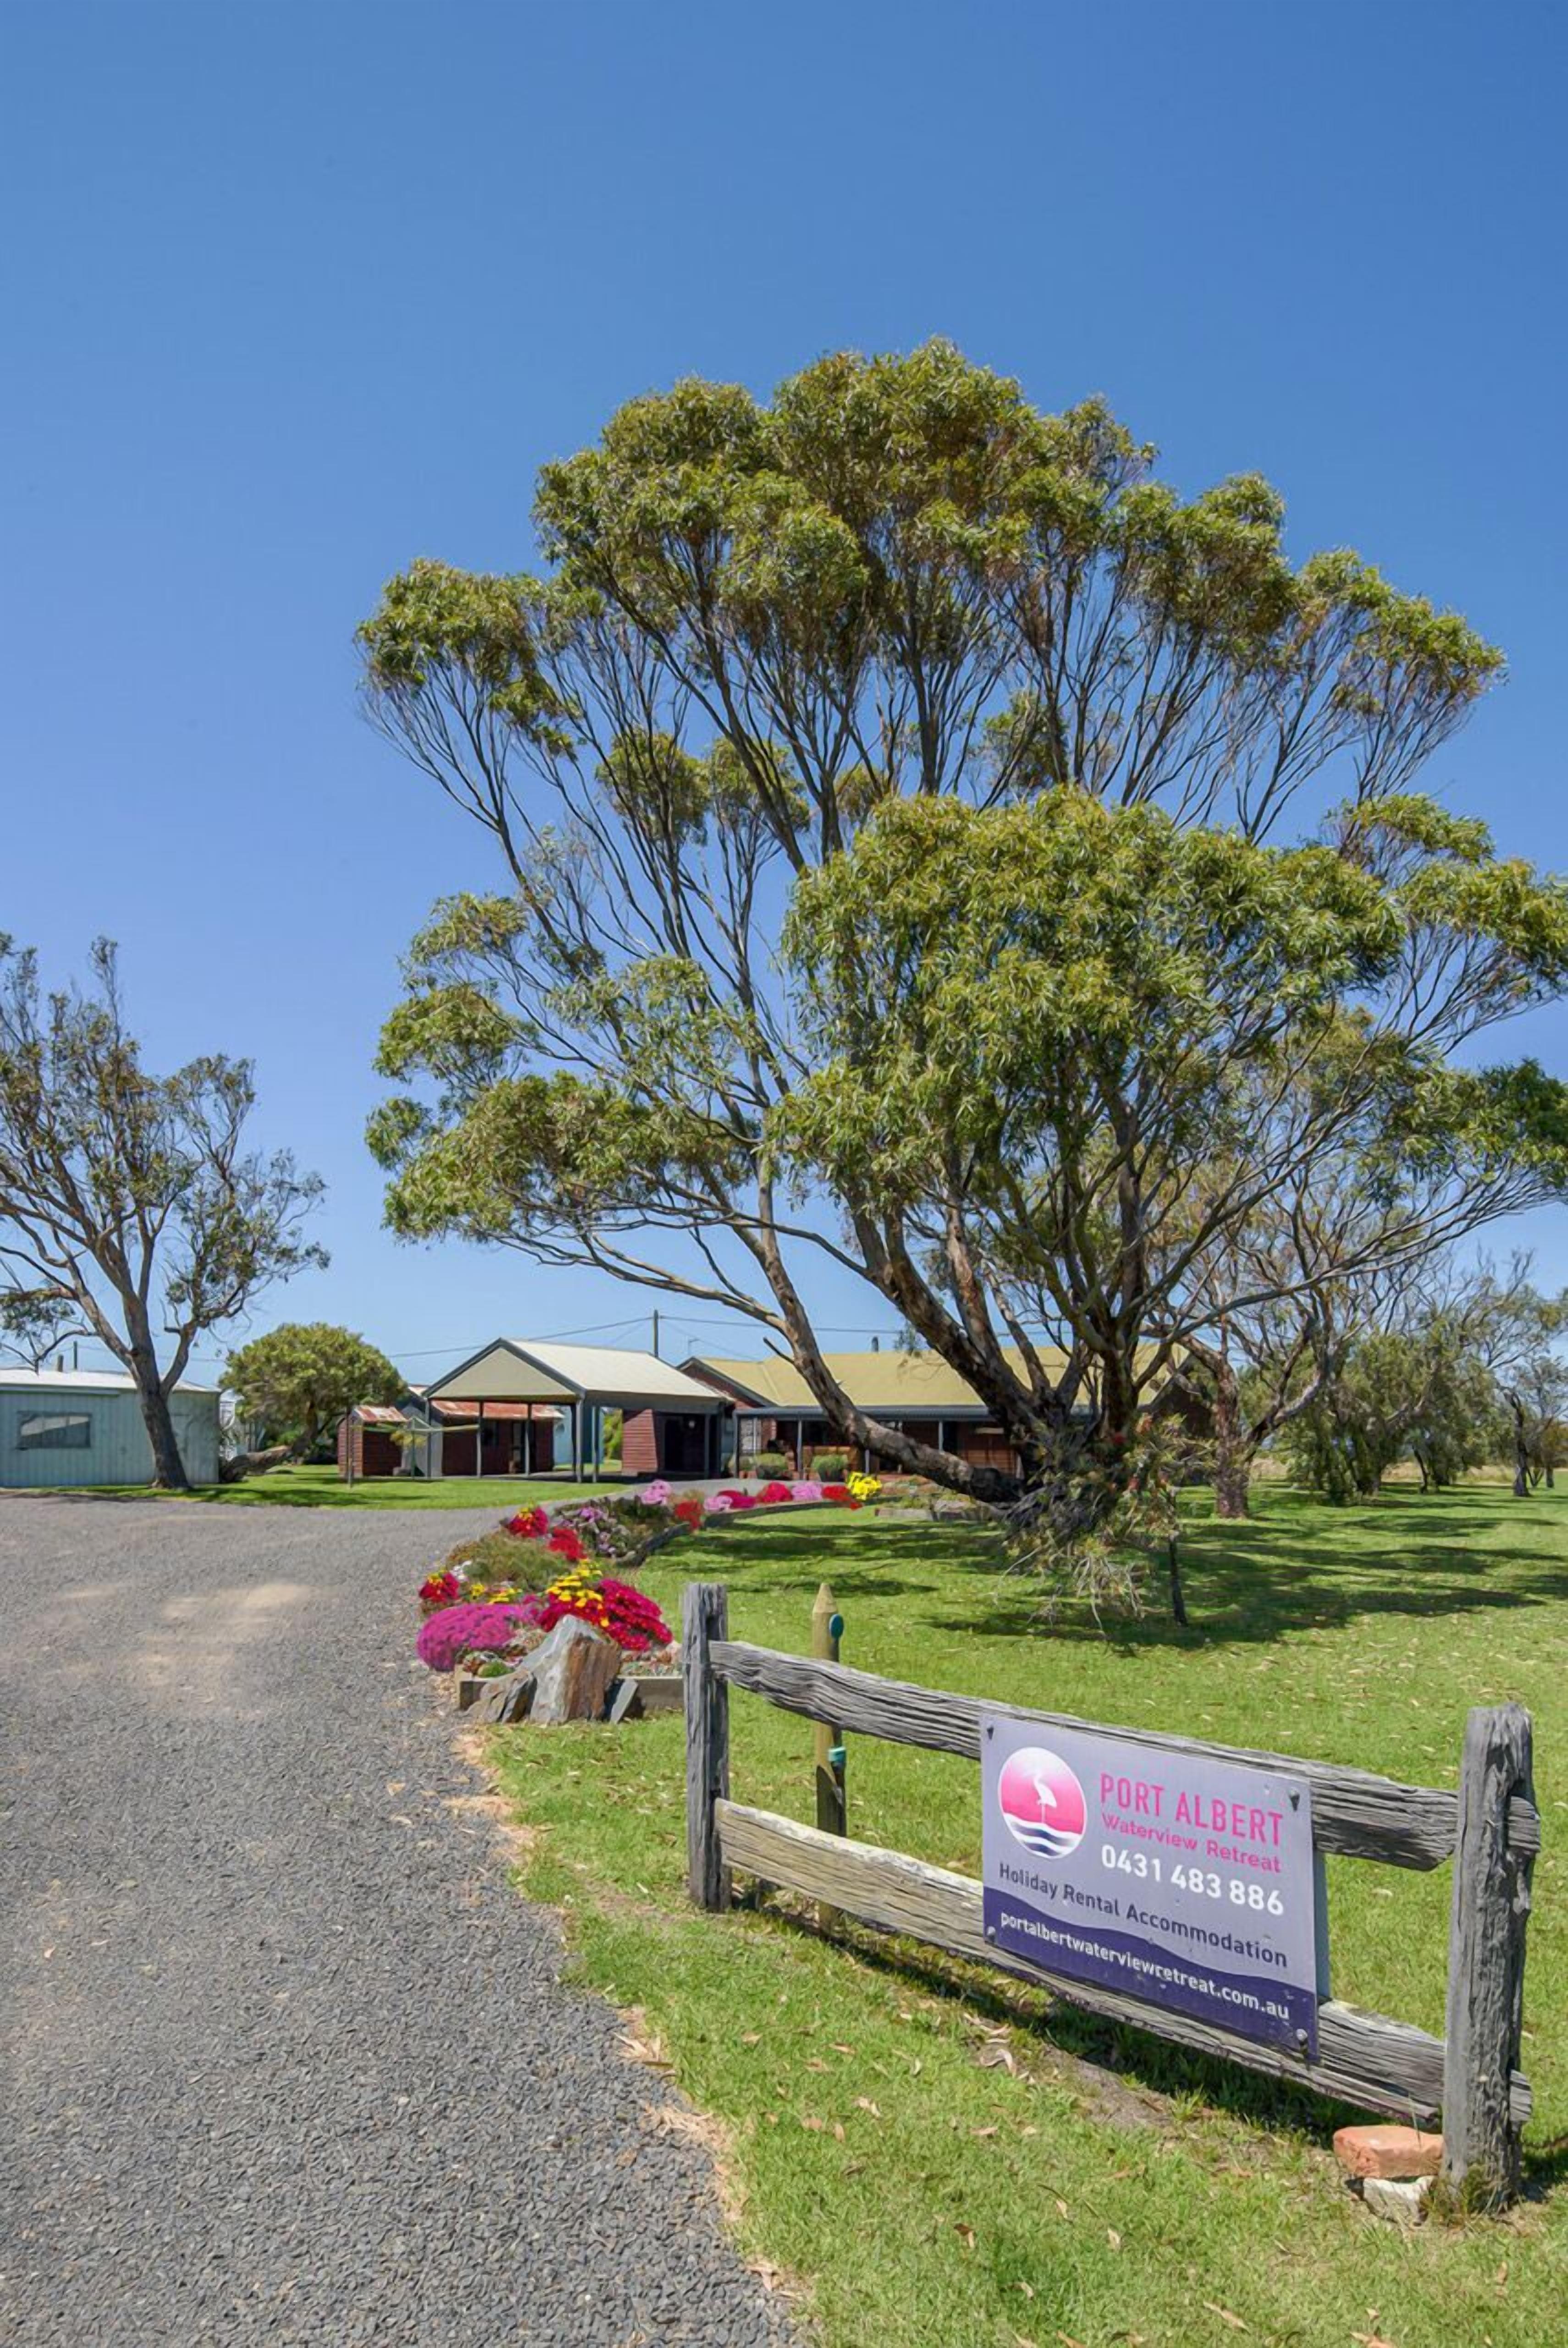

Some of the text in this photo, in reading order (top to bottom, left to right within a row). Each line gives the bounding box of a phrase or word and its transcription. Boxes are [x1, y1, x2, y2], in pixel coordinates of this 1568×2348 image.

[1101, 1773, 1283, 1846] PORT ALBERT
[1102, 1812, 1281, 1872] Waterview Retreat
[999, 1863, 1288, 1968] Holiday Rental Accommodation
[1102, 1844, 1284, 1916] 0431 483 886
[1001, 1912, 1290, 2021] portalbertwaterviewretreat.com.au
